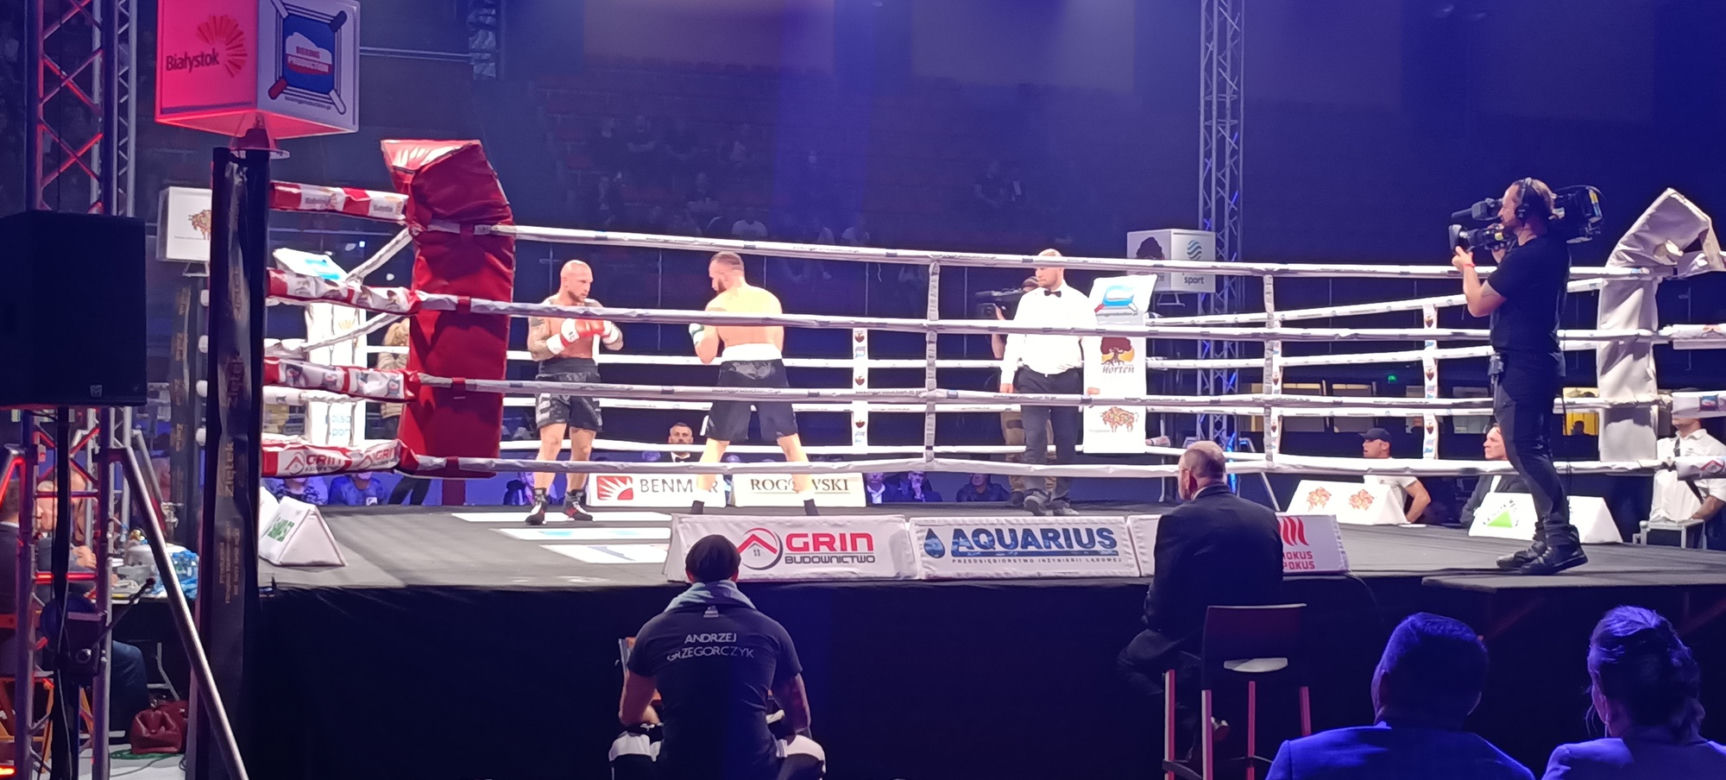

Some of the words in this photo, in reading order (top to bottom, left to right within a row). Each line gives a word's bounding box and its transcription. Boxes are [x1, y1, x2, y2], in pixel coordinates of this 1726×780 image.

[166, 48, 219, 72] Białystok
[1184, 276, 1204, 285] sport
[640, 478, 718, 493] BENMR
[751, 478, 848, 491] ROGSKI
[786, 532, 874, 552] GRIN
[951, 528, 1117, 550] AQUARIUS
[785, 555, 876, 565] BUDOWNICTWO
[1283, 551, 1313, 560] OKUS
[684, 633, 737, 644] ANDRZEJ
[667, 646, 754, 661] GRZEGORCZYK
